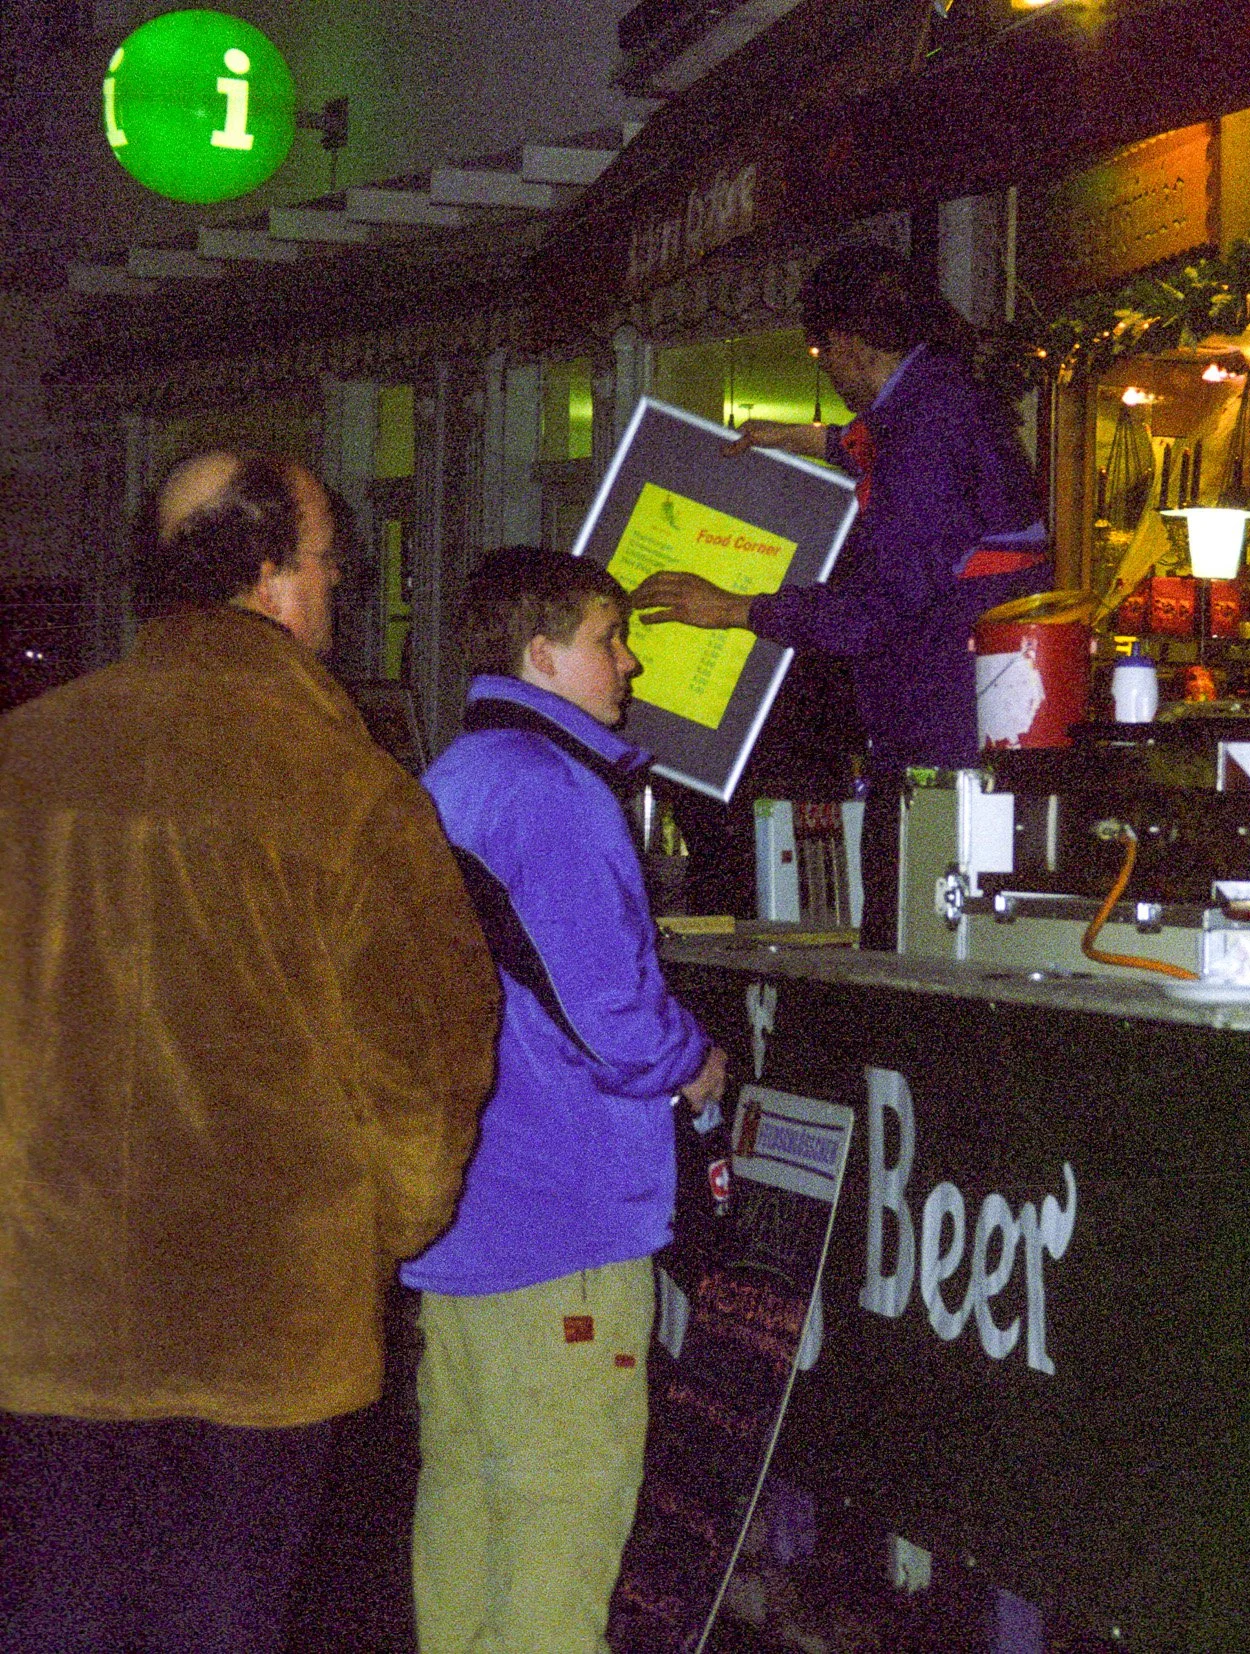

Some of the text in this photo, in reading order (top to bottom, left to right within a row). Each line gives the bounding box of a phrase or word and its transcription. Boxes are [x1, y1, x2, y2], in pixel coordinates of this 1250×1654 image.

[210, 48, 255, 151] i
[695, 529, 782, 557] Food Corner
[859, 1065, 1078, 1376] Beer
